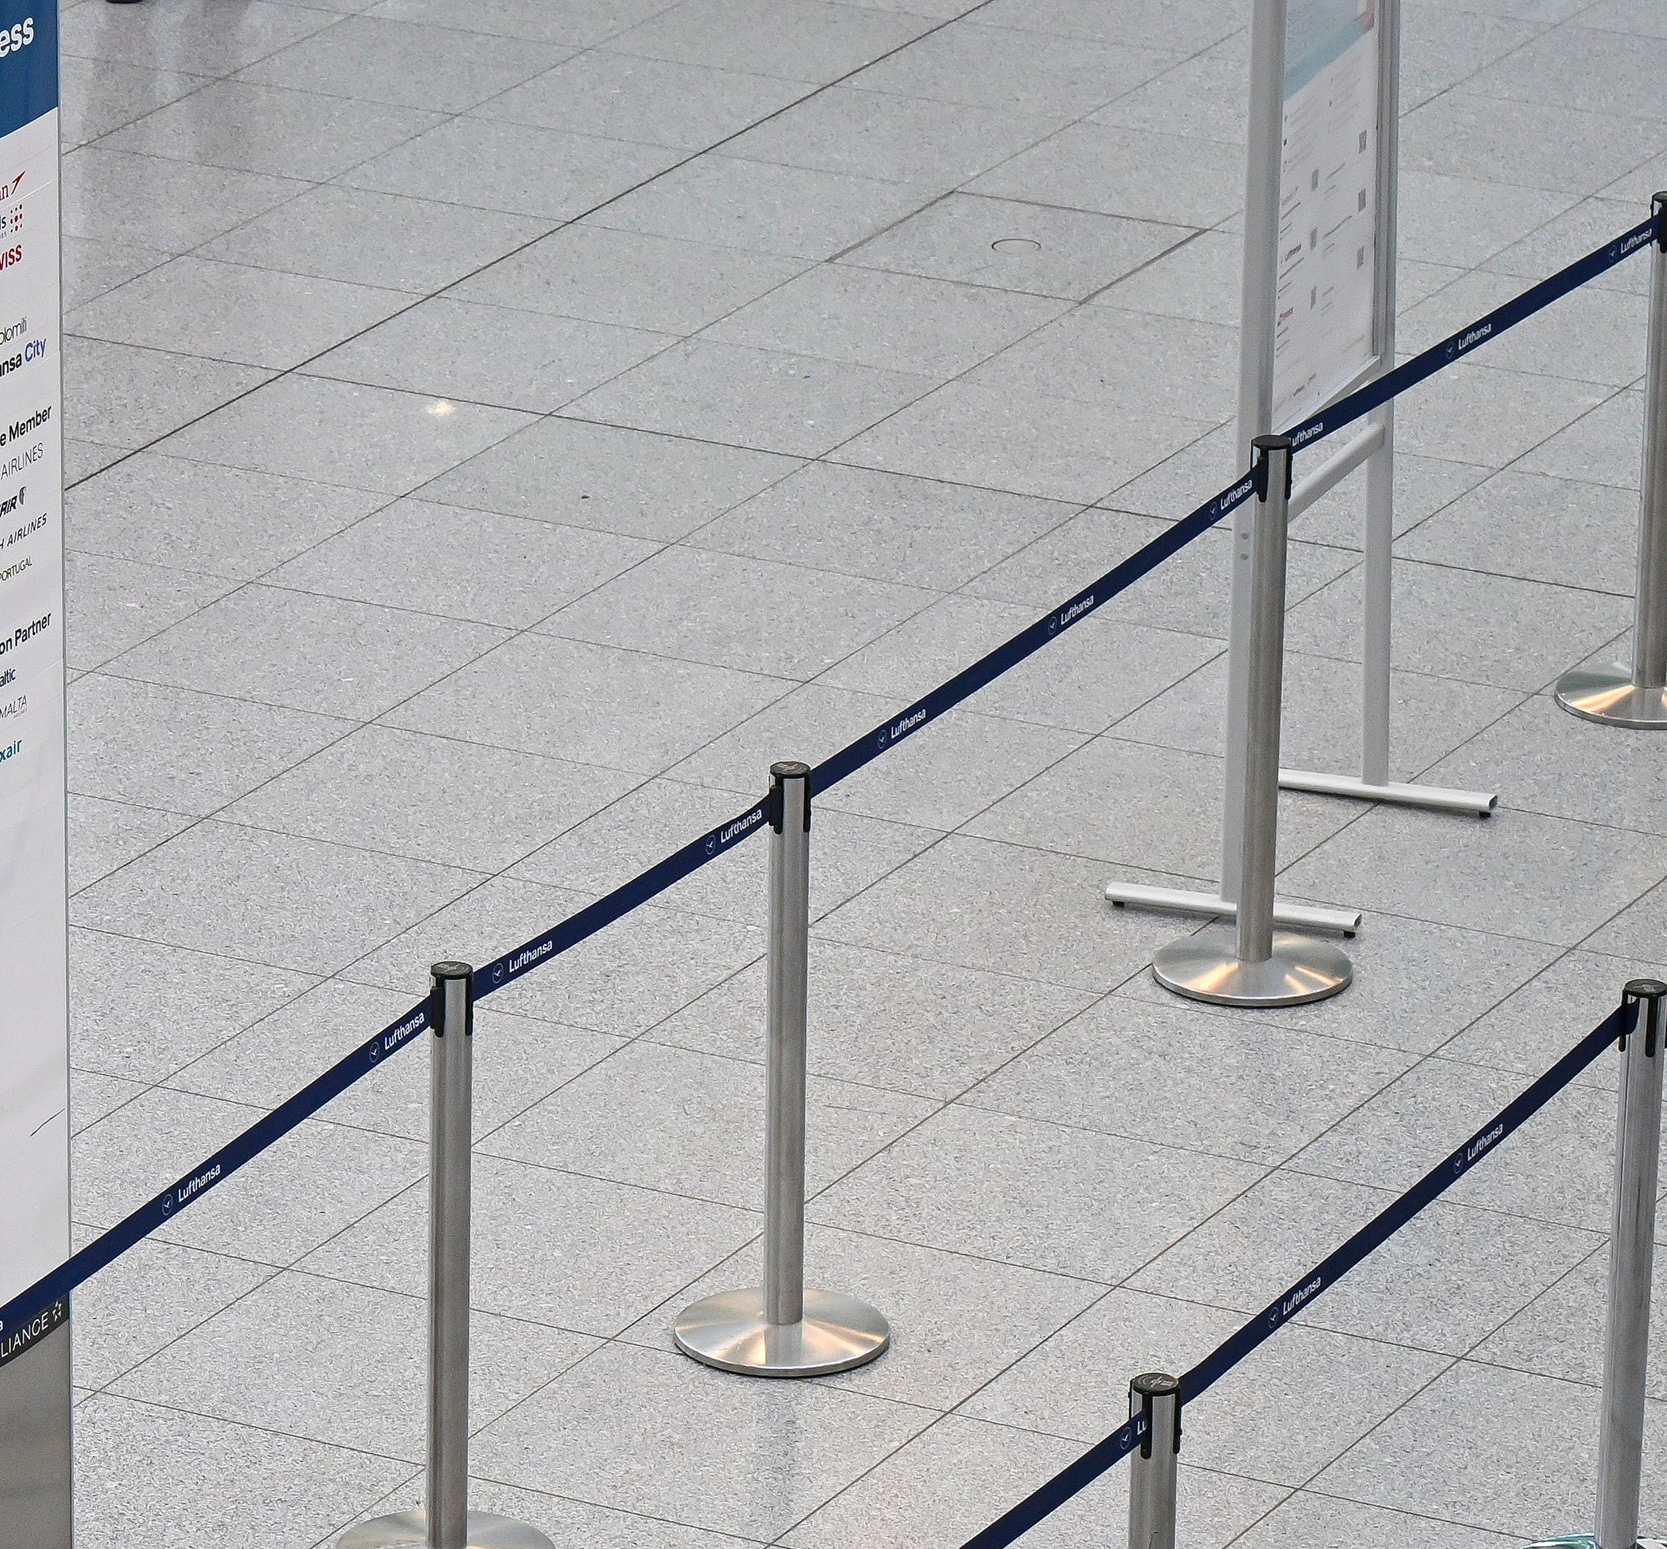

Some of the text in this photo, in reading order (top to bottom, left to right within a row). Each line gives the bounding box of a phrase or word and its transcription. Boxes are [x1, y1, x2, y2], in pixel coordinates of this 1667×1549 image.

[1620, 228, 1652, 254] Lufthansa
[24, 338, 47, 363] City
[1457, 323, 1492, 350] Lufthansa
[8, 406, 52, 442] Member
[1289, 422, 1323, 447] ufthansa
[0, 442, 44, 480] AIRLINES
[1220, 479, 1253, 510] Lufthansa
[7, 512, 48, 547] AIRLINES
[1060, 594, 1094, 625] Lufthansa
[15, 612, 52, 647] Partner
[890, 707, 926, 739] Lufthansa
[720, 808, 762, 844] Lufthansa
[509, 940, 553, 974] Lufthansa
[384, 1011, 425, 1051] Lufthansa
[1467, 1123, 1504, 1162] Lufthansa
[178, 1163, 221, 1203] Lufthansa
[1282, 1276, 1321, 1317] Lufthansa
